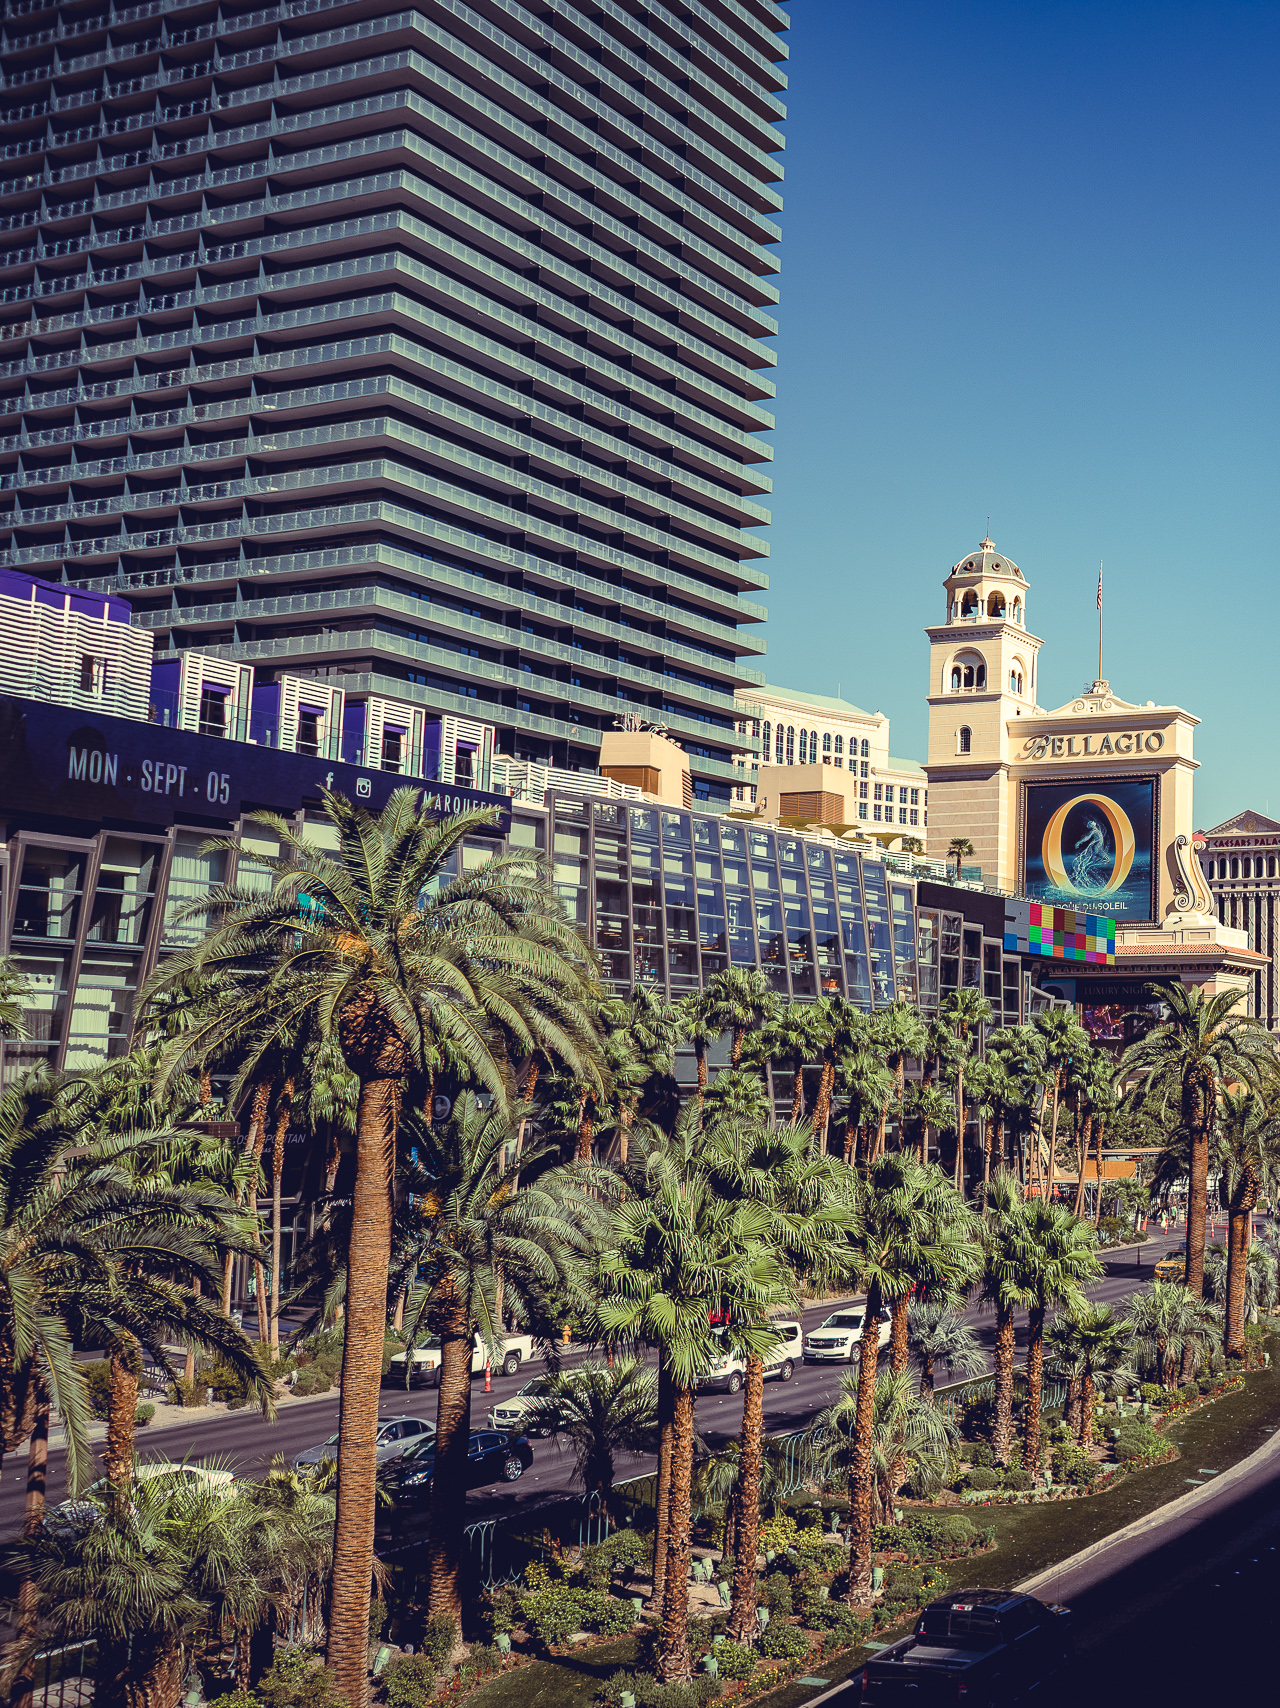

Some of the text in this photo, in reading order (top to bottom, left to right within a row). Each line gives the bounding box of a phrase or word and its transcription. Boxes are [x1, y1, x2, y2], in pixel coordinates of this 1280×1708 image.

[68, 746, 230, 804] MON SEPT 05
[1213, 838, 1252, 848] CAESARS
[1097, 901, 1128, 911] SOLEIL
[1084, 986, 1120, 995] LUXURY
